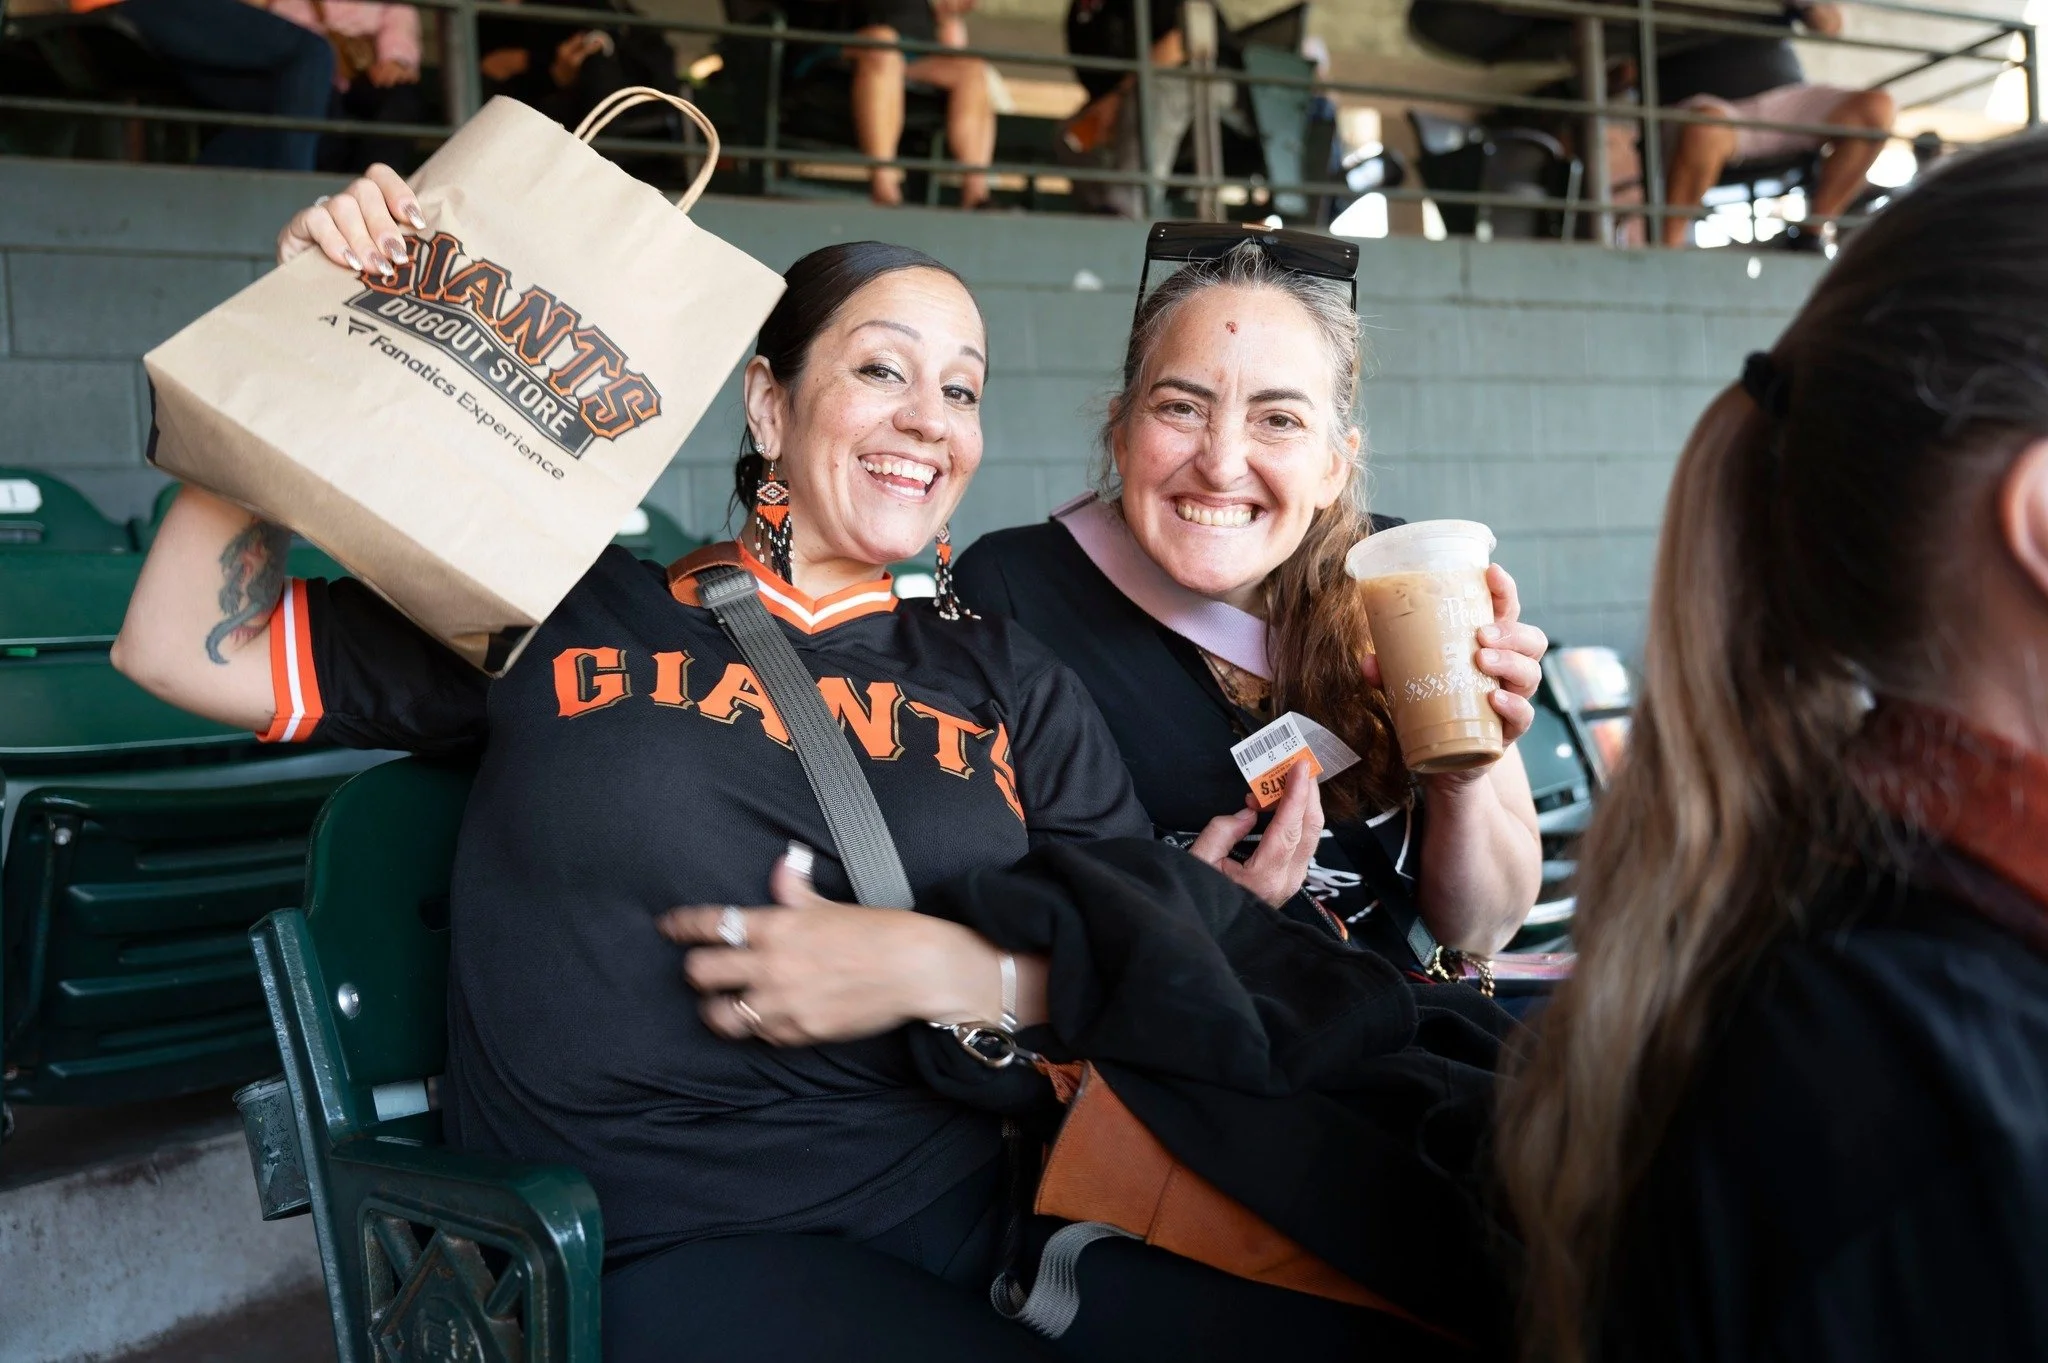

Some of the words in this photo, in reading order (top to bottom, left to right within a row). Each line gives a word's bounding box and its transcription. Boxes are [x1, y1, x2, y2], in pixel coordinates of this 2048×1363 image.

[318, 314, 338, 327] A
[370, 334, 457, 396] Fanatics
[457, 391, 565, 480] Experience
[378, 297, 494, 363] DUGOUT
[489, 358, 576, 437] STORE
